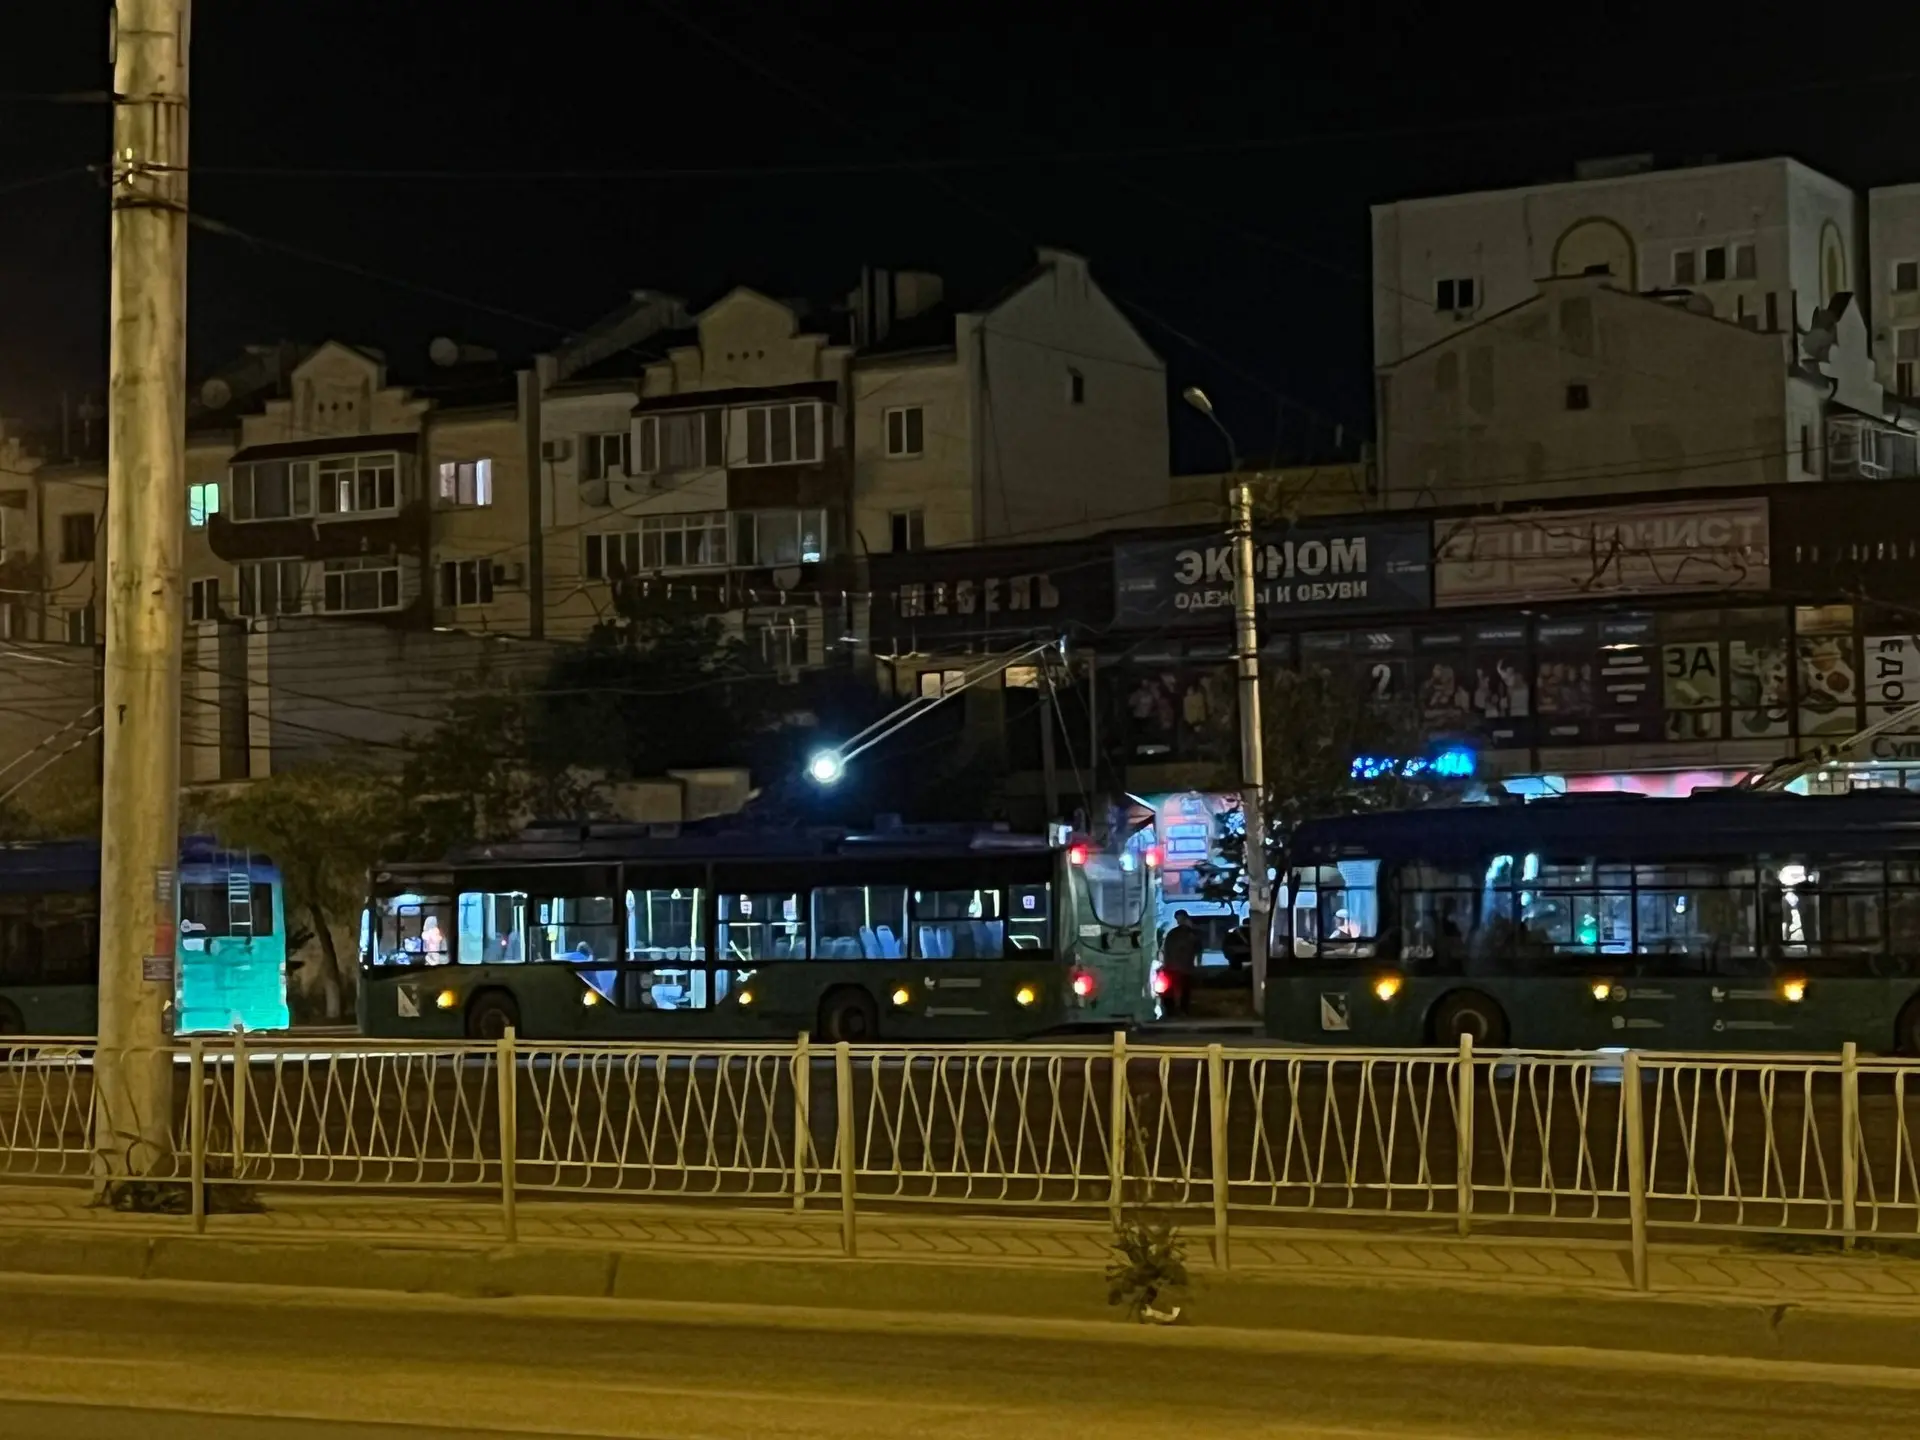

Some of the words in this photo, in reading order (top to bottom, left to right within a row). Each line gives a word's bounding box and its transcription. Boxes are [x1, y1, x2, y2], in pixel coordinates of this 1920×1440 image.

[1174, 588, 1270, 612] ОДЕЖЫ
[1276, 585, 1291, 603] И
[1296, 581, 1368, 602] ОБУВИ
[1667, 646, 1716, 679] ЗА
